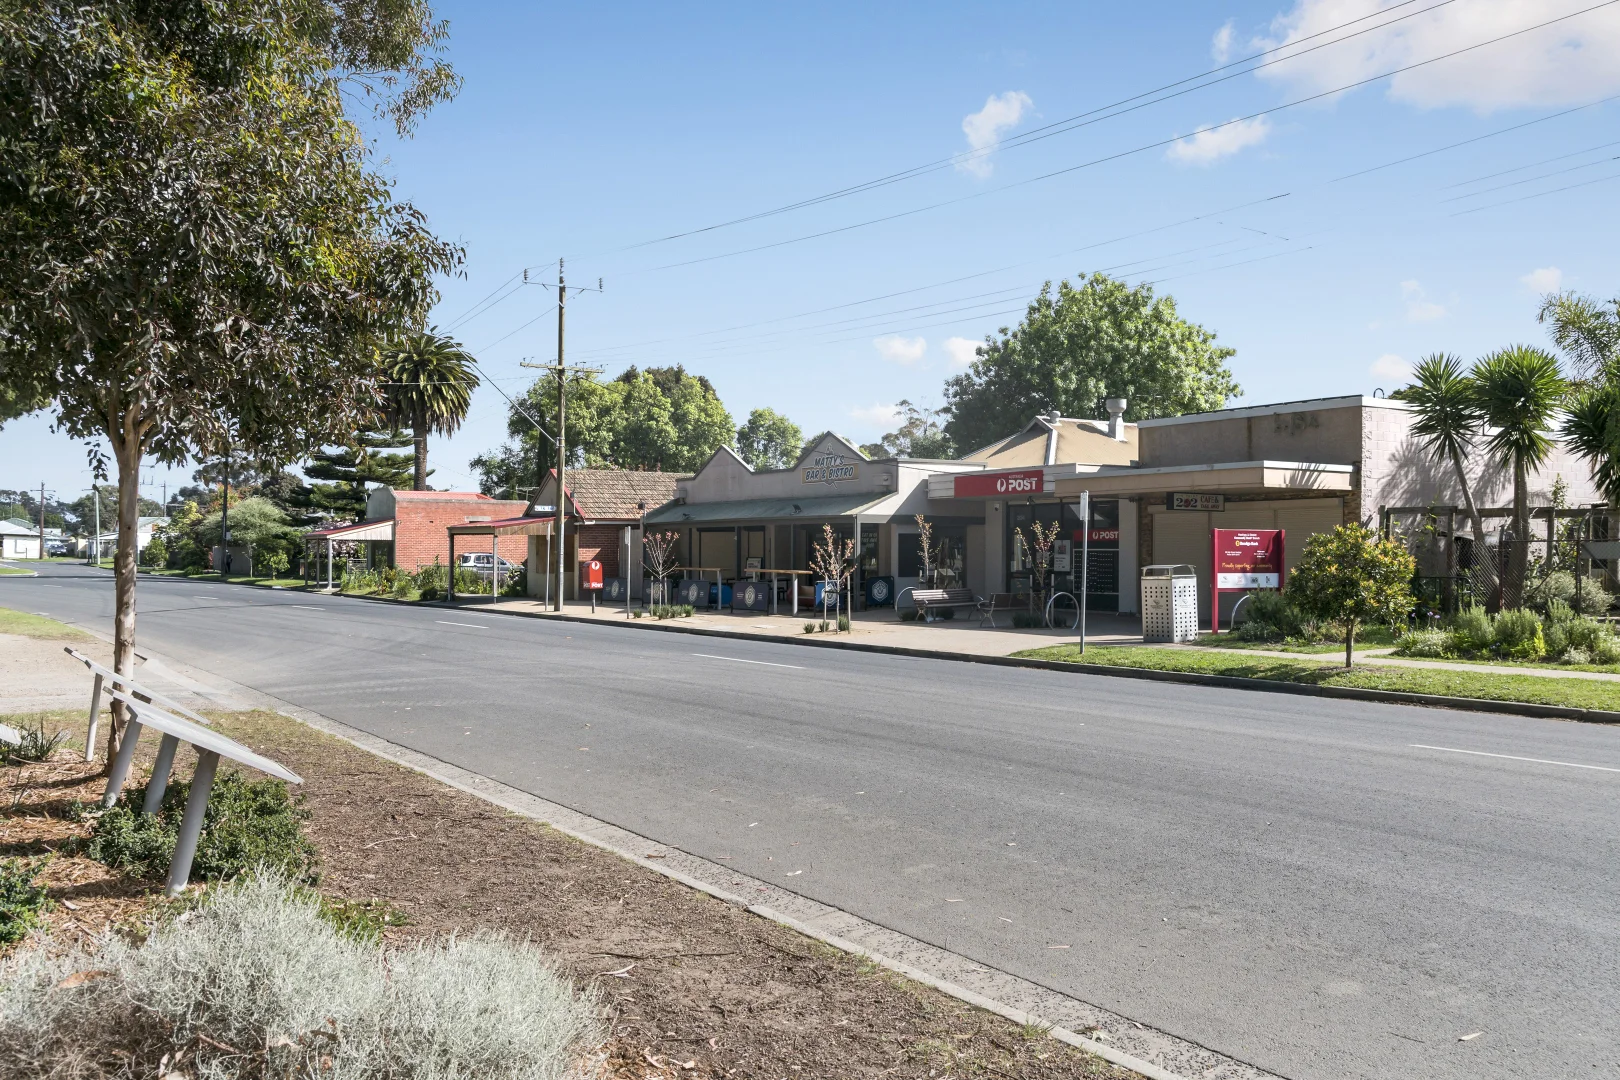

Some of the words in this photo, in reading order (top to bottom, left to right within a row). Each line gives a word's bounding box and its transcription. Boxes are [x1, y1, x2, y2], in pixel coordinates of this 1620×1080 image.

[815, 455, 844, 467] MATTY'S
[806, 471, 819, 480] BAR
[821, 469, 826, 479] &
[829, 467, 854, 478] BISTRO
[1009, 478, 1037, 491] POST
[1100, 531, 1119, 539] POST
